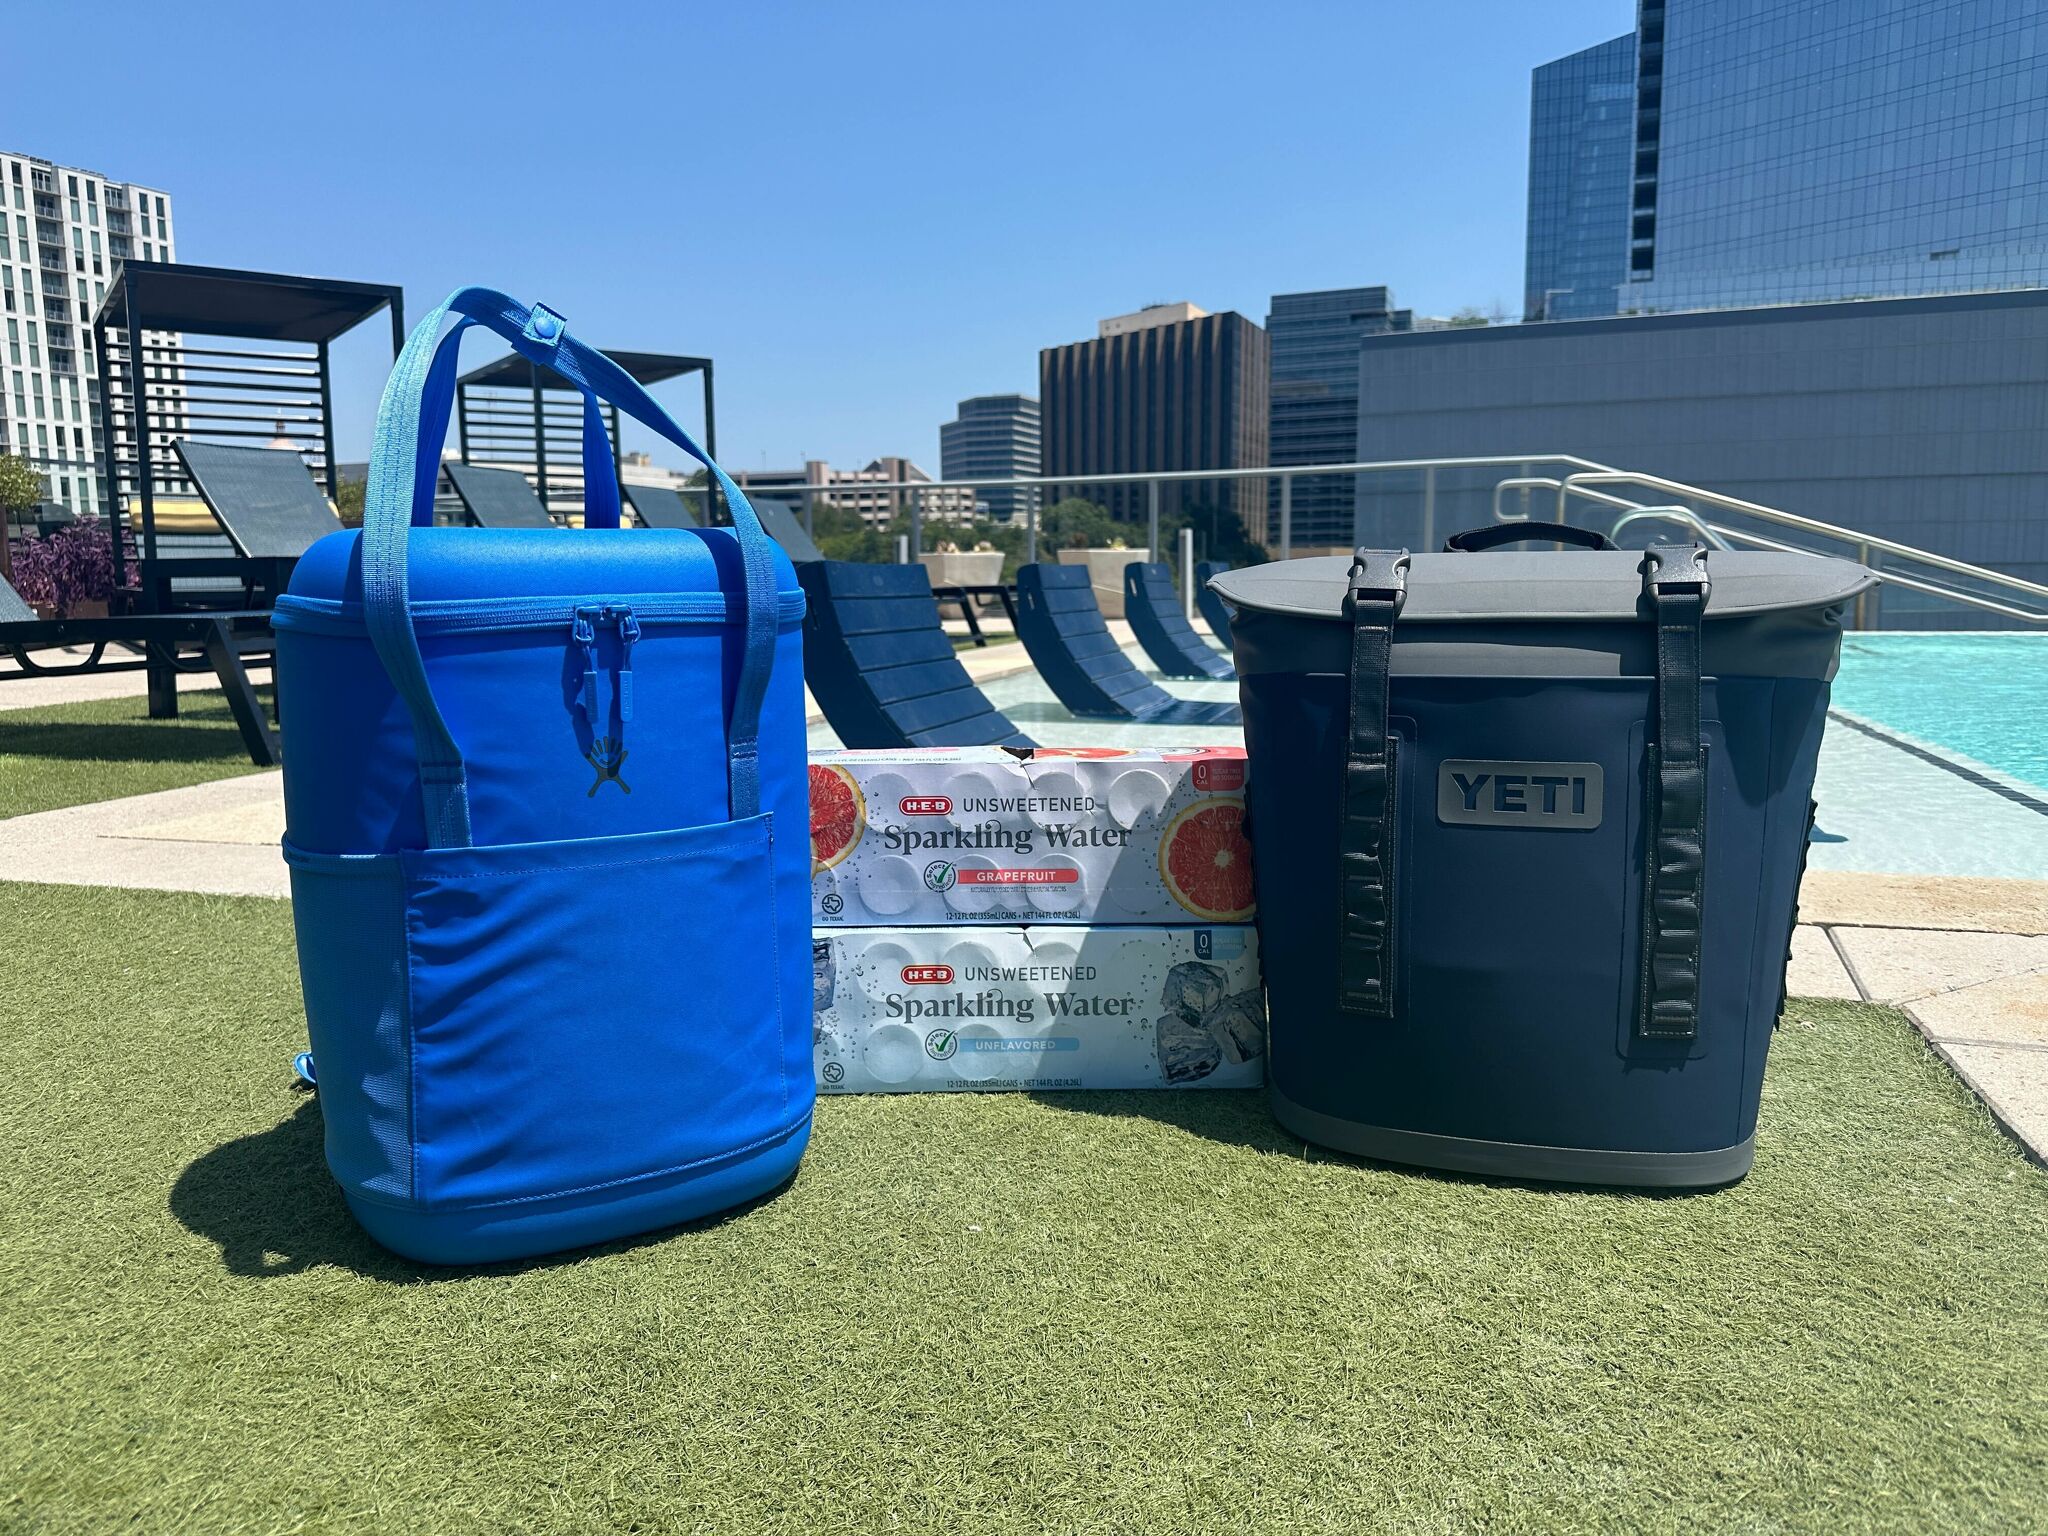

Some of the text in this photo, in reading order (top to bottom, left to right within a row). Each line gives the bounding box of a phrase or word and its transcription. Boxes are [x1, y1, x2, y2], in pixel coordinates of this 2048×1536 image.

[1198, 765, 1206, 779] 0
[1451, 773, 1585, 815] YETI
[963, 797, 1095, 813] UNSWEETENED
[884, 819, 1132, 855] Sparkling Water
[976, 871, 1056, 882] GRAPEFRUIT
[1001, 911, 1017, 920] CANS
[1022, 911, 1034, 919] NET
[1200, 934, 1208, 948] 0
[964, 966, 1096, 981] UNSWEETENED
[885, 988, 1134, 1024] Sparkling Water
[975, 1040, 1056, 1050] UNFLAVORED
